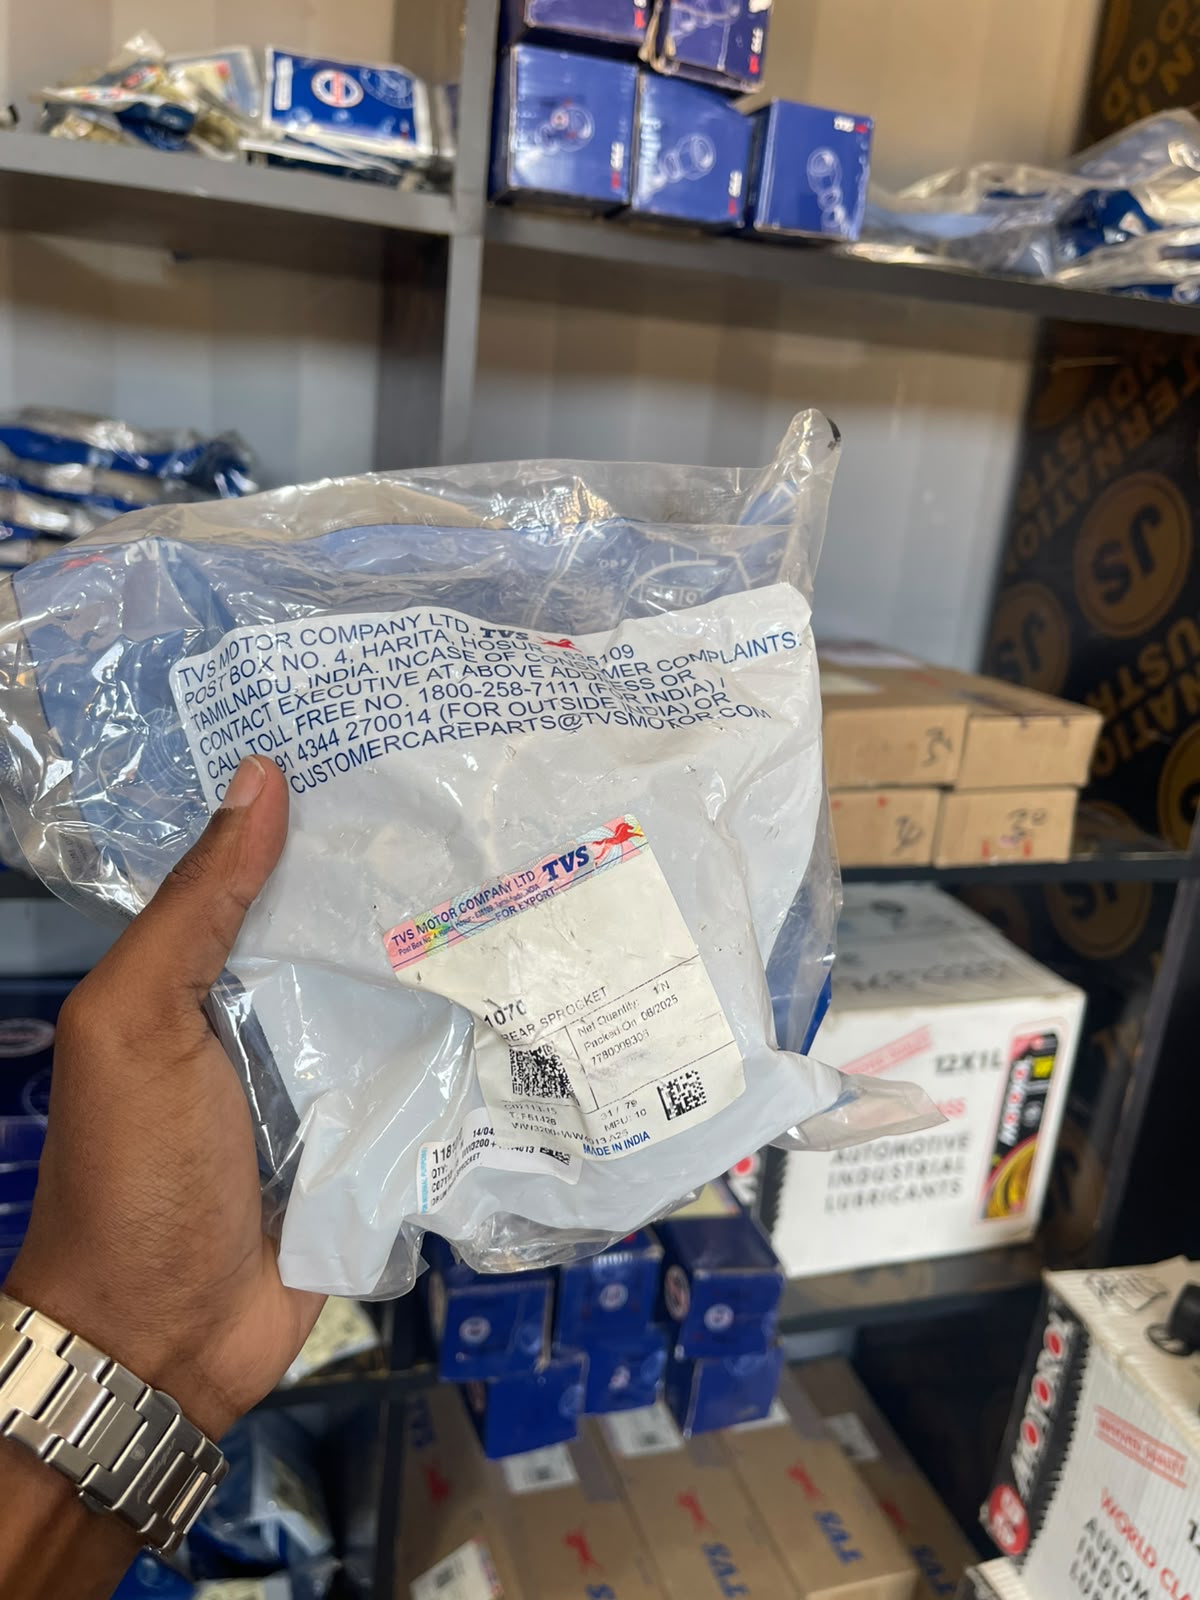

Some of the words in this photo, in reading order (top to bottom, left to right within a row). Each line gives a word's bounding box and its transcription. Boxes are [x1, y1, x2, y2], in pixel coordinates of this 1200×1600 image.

[178, 660, 215, 687] TVS
[220, 632, 293, 670] MOTOR
[300, 613, 421, 646] COMPANY
[429, 613, 477, 636] LTD.
[480, 627, 529, 640] TVS
[184, 673, 227, 710] POST
[230, 656, 274, 686] BOX
[282, 651, 327, 672] NO.
[334, 649, 354, 664] 4,
[362, 629, 455, 658] HARITA,
[461, 636, 543, 654] HOSUR
[309, 662, 379, 689] INDIA.
[389, 646, 477, 671] INCASE
[485, 652, 516, 662] OF
[200, 702, 272, 756] CONTACT
[279, 671, 420, 715] EXECUTIVE
[426, 664, 454, 682] AT
[462, 664, 544, 678] ABOVE
[661, 669, 696, 687] OR
[208, 748, 241, 779] CALL
[245, 725, 293, 754] TOLL
[295, 701, 357, 735] FREE
[365, 693, 409, 713] NO.
[419, 680, 579, 704] 1800-258-7111
[645, 679, 715, 704] INDIA)
[298, 728, 340, 761] 4344
[346, 709, 431, 742] 270014
[440, 702, 501, 724] (FOR
[508, 697, 617, 717] OUTSIDE
[694, 691, 731, 709] OR
[542, 845, 590, 881] TVS
[392, 929, 415, 946] TVS
[416, 907, 458, 934] MOTOR
[458, 881, 513, 913] COMPANY
[495, 905, 518, 921] FOR
[519, 885, 557, 911] EXPORT
[540, 986, 608, 1028] SPROCKET
[577, 1021, 597, 1037] Net
[583, 1026, 621, 1052] Packed
[622, 1019, 638, 1031] On
[583, 1142, 610, 1158] MADE
[612, 1140, 623, 1153] IN
[624, 1131, 651, 1149] INDIA
